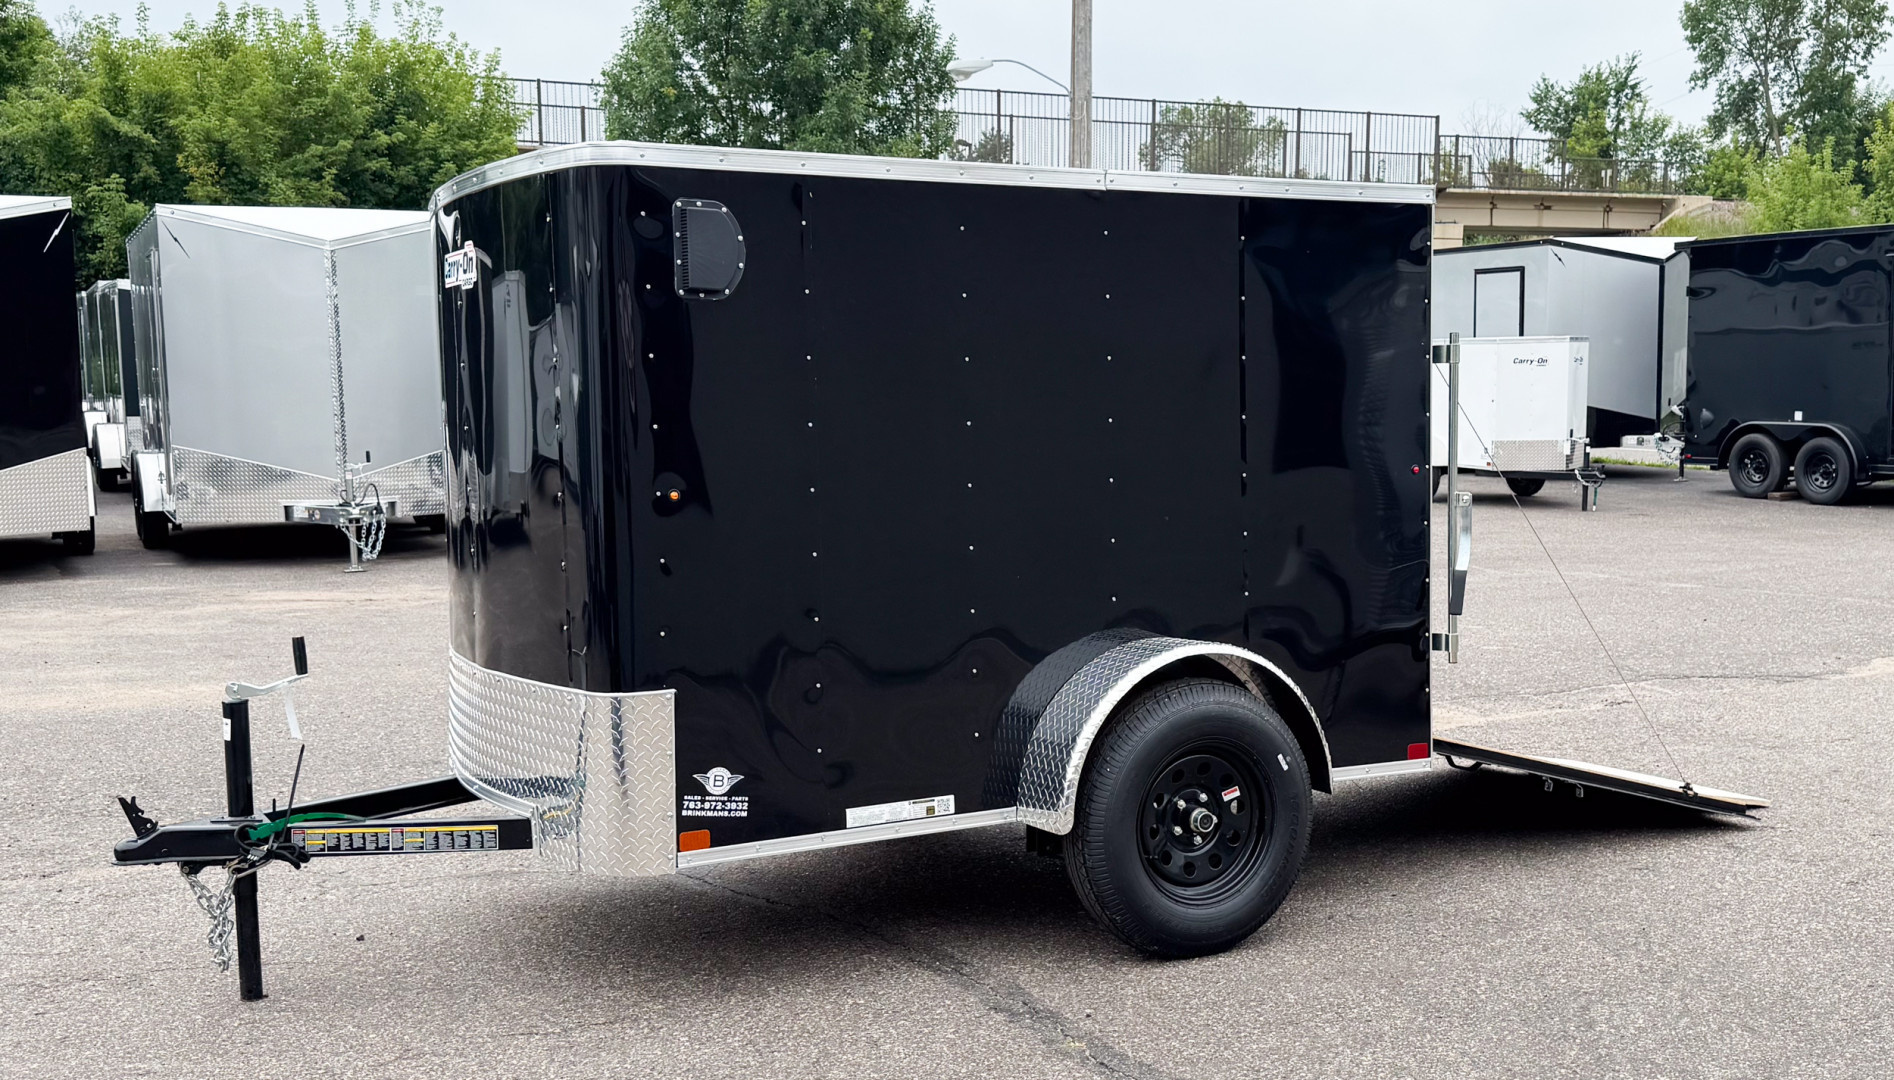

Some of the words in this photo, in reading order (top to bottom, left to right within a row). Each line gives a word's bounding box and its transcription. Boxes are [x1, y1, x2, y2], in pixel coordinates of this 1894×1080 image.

[713, 774, 725, 787] B
[682, 801, 749, 810] 763-972-3932
[681, 809, 748, 817] BRINKMANS.COM
